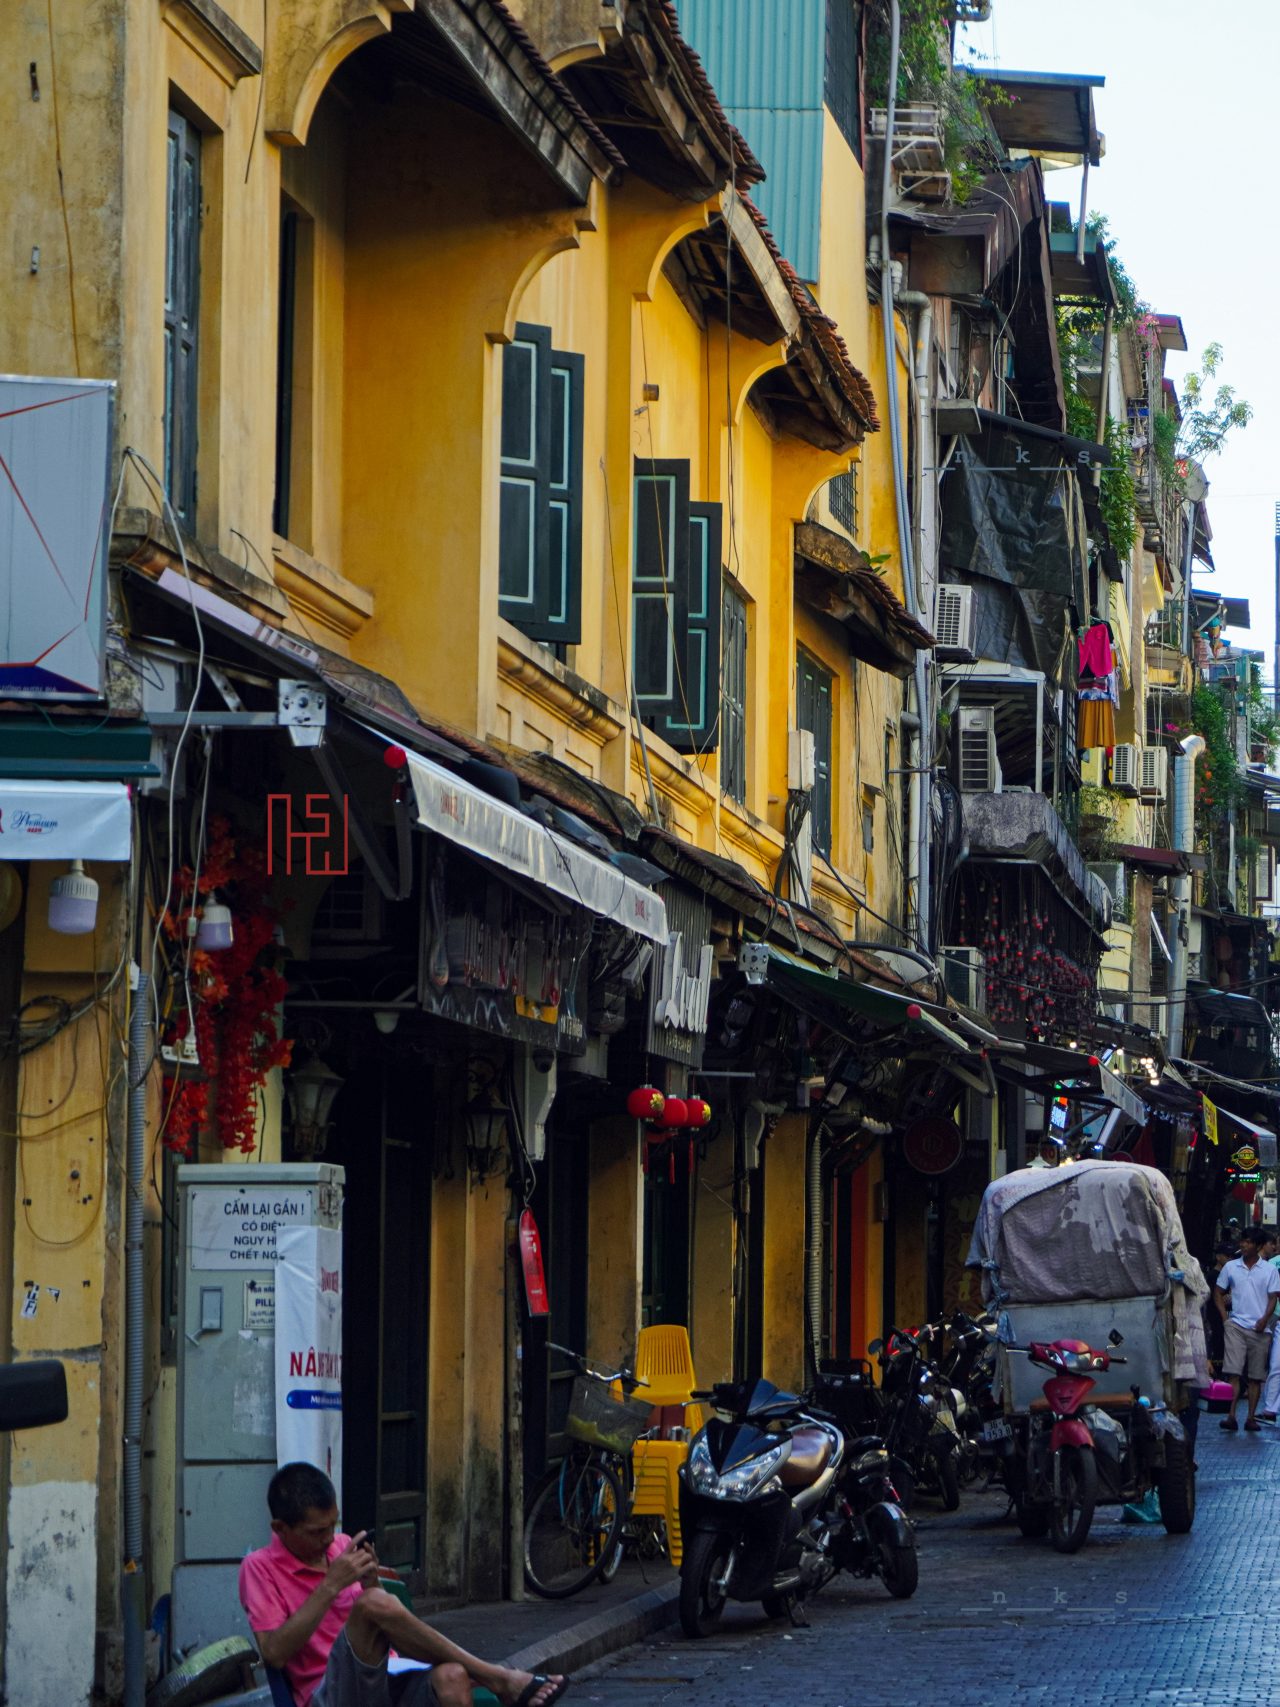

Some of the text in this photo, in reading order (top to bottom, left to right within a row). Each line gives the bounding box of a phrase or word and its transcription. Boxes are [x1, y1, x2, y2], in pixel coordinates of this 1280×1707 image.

[253, 1203, 271, 1219] LẠI
[234, 1235, 265, 1247] NGUY
[230, 1247, 260, 1260] CHẾT
[255, 1298, 275, 1307] PILL
